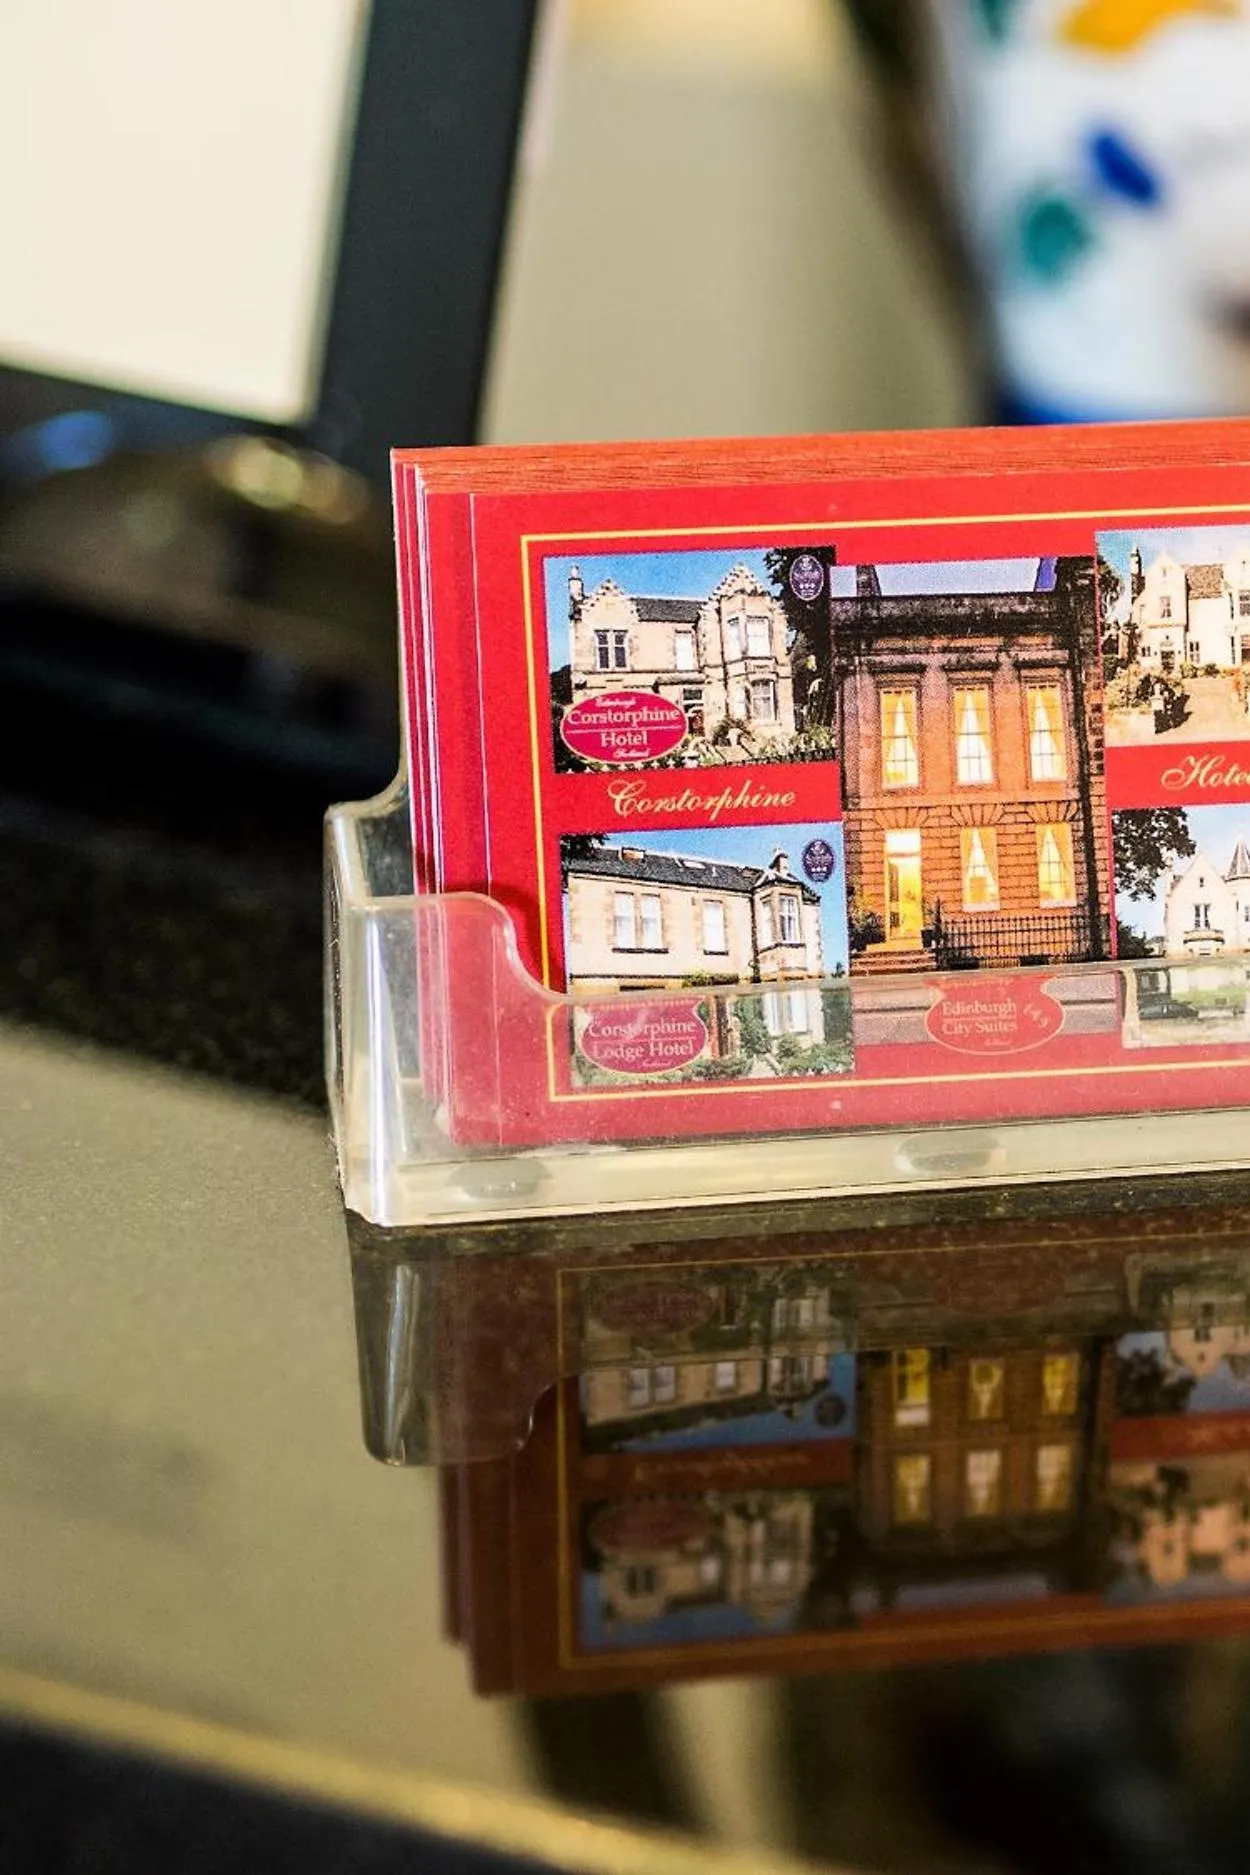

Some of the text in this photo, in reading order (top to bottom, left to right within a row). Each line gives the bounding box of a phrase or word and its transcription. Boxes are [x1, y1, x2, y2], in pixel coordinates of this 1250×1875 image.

[567, 706, 681, 730] Corstorphine
[601, 730, 649, 748] Hotel
[607, 779, 798, 821] Corstorphine
[942, 998, 1017, 1018] Edinburgh
[588, 1017, 697, 1041] Corstrphine
[942, 1020, 1018, 1038] City Suites
[592, 1039, 695, 1063] Lodge Hotel
